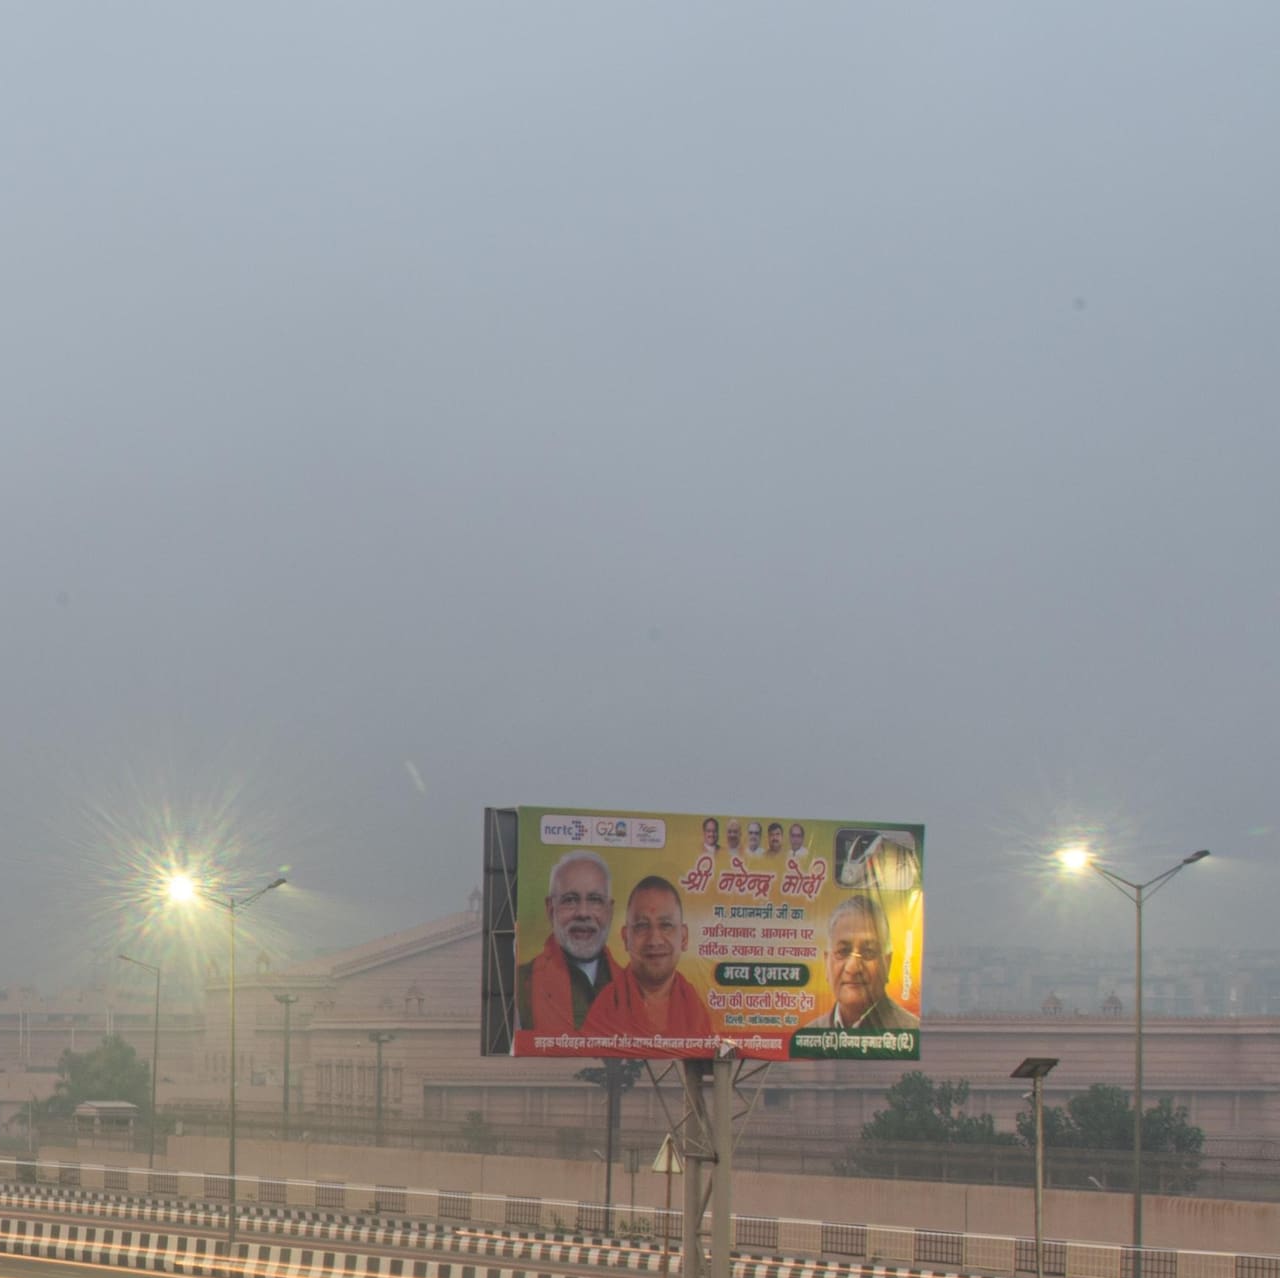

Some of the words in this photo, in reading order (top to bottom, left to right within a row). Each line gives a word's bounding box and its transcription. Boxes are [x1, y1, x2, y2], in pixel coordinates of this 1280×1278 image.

[681, 856, 712, 891] श्री
[782, 859, 826, 897] मोदी
[801, 929, 814, 941] पर
